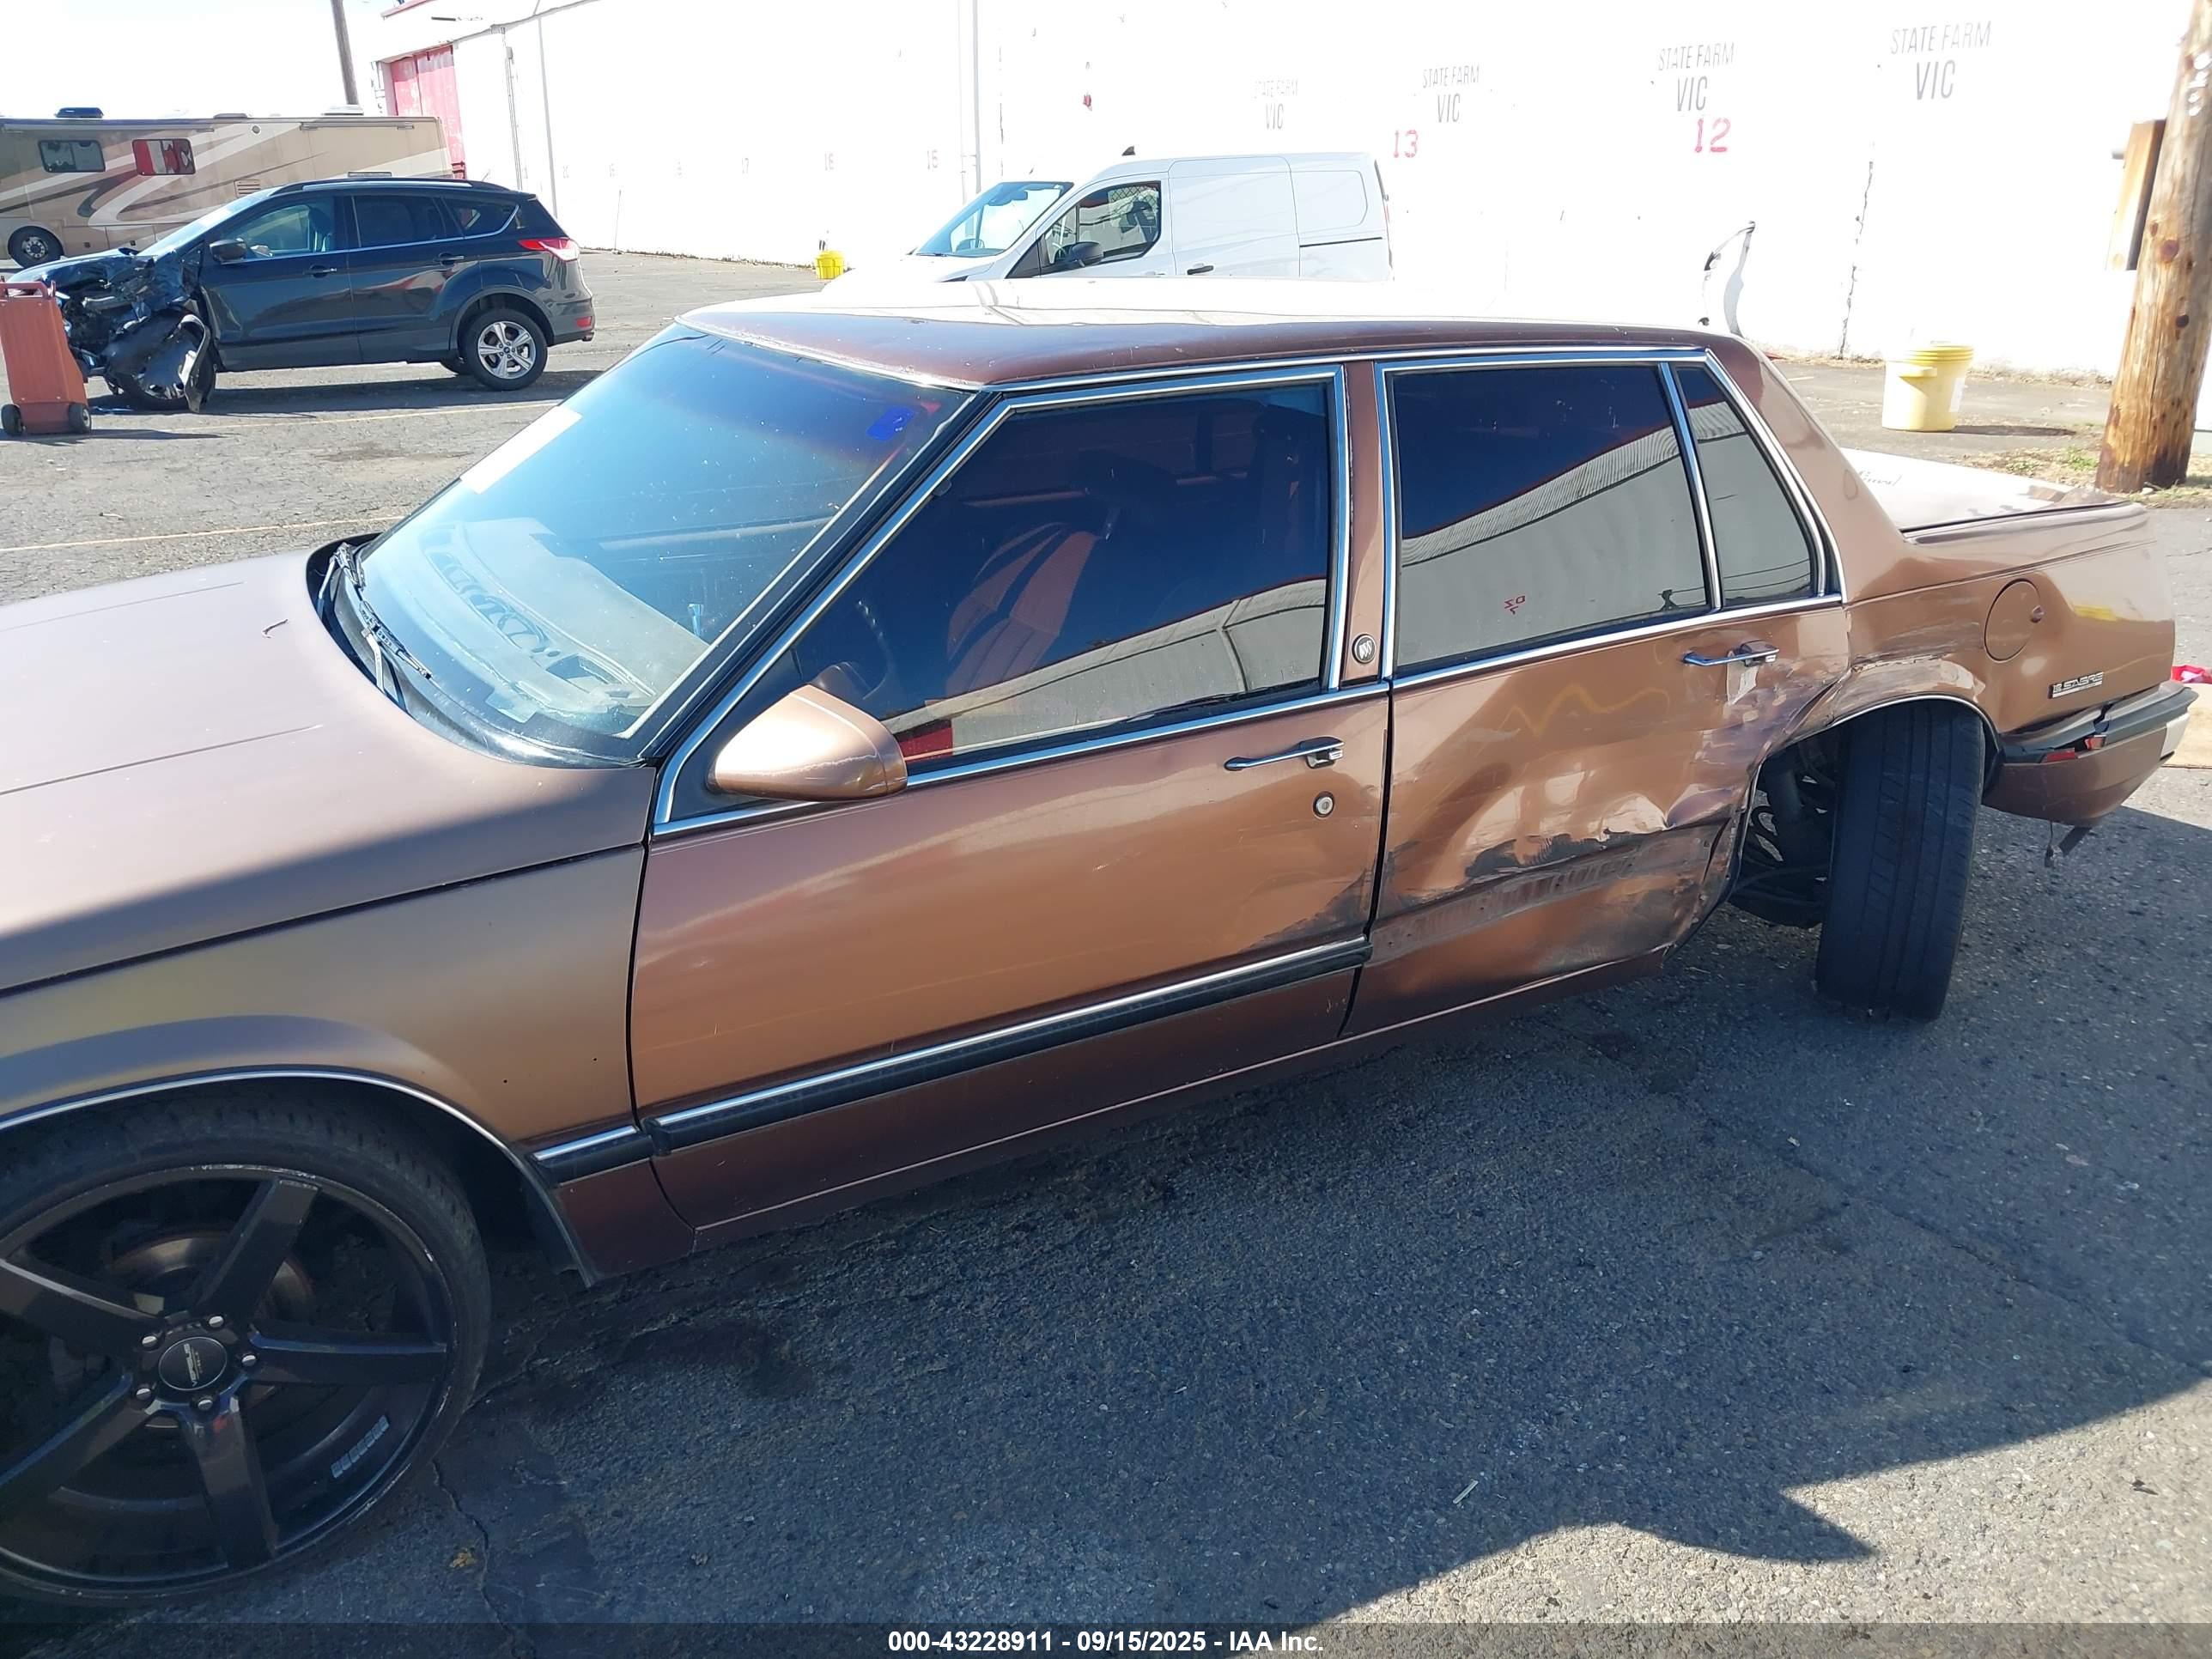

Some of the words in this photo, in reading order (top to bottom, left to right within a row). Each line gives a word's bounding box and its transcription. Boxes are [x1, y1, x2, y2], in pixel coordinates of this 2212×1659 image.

[1891, 25, 1937, 55] STATE
[1941, 20, 1991, 50] FARM
[1658, 45, 1693, 71] STATE
[1696, 42, 1735, 68] FARM
[1422, 67, 1450, 89] STATE
[1451, 64, 1480, 85] FARM
[1916, 59, 1956, 100] VIC
[1437, 92, 1461, 124] VIC
[1676, 76, 1708, 112] VIC
[1266, 102, 1285, 130] VIC
[1393, 129, 1419, 159] 13
[1693, 118, 1731, 154] 12
